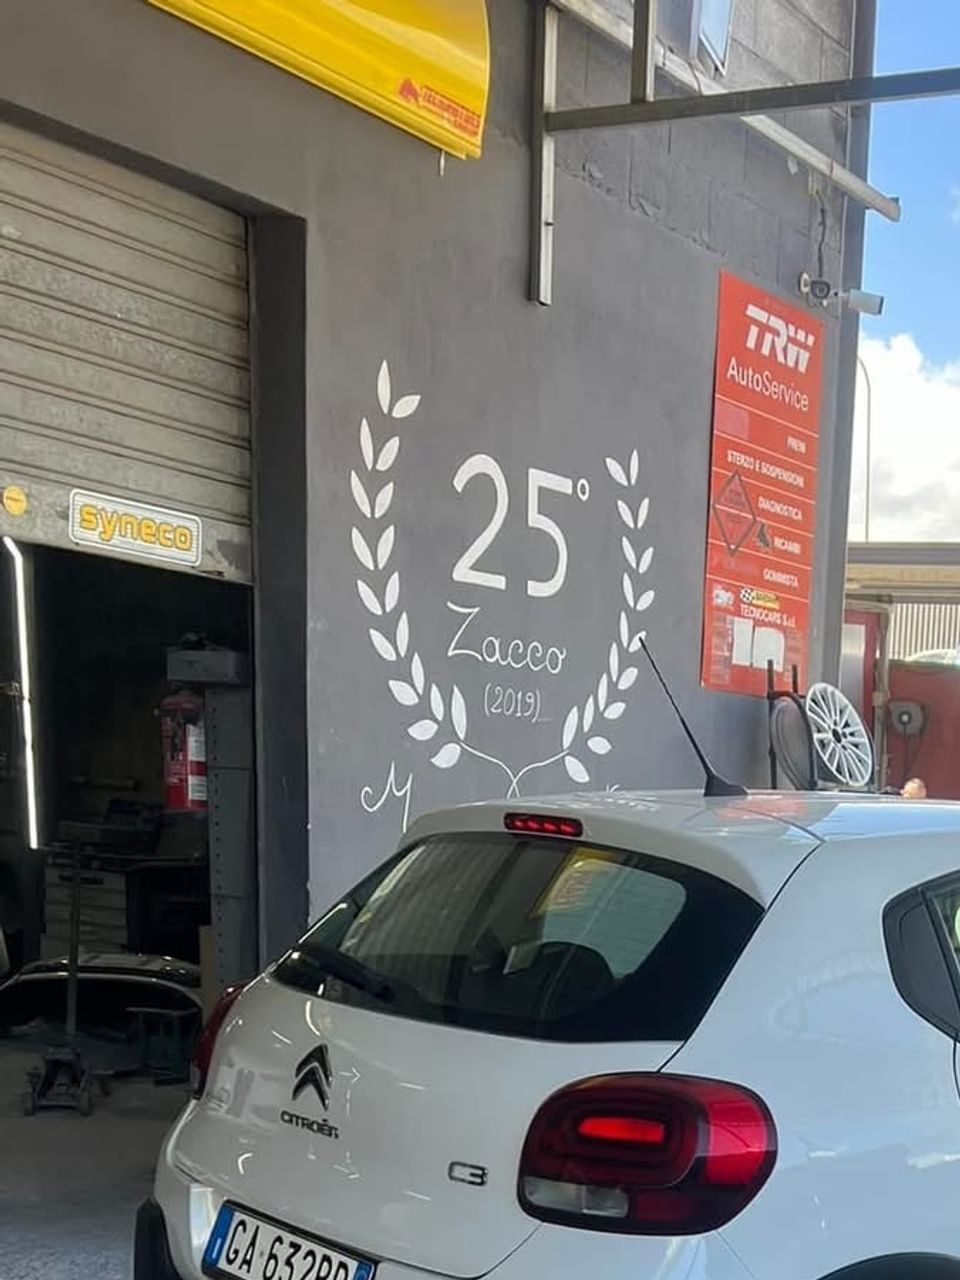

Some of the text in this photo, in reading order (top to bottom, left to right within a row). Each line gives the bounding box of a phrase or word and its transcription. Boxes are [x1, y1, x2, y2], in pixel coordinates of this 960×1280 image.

[745, 303, 816, 374] TRW
[726, 356, 809, 411] AutoService
[79, 504, 193, 551] syneco
[446, 600, 567, 673] Zacco
[280, 1110, 339, 1139] CITROËN
[448, 1161, 488, 1186] C3
[225, 1219, 260, 1274] GA
